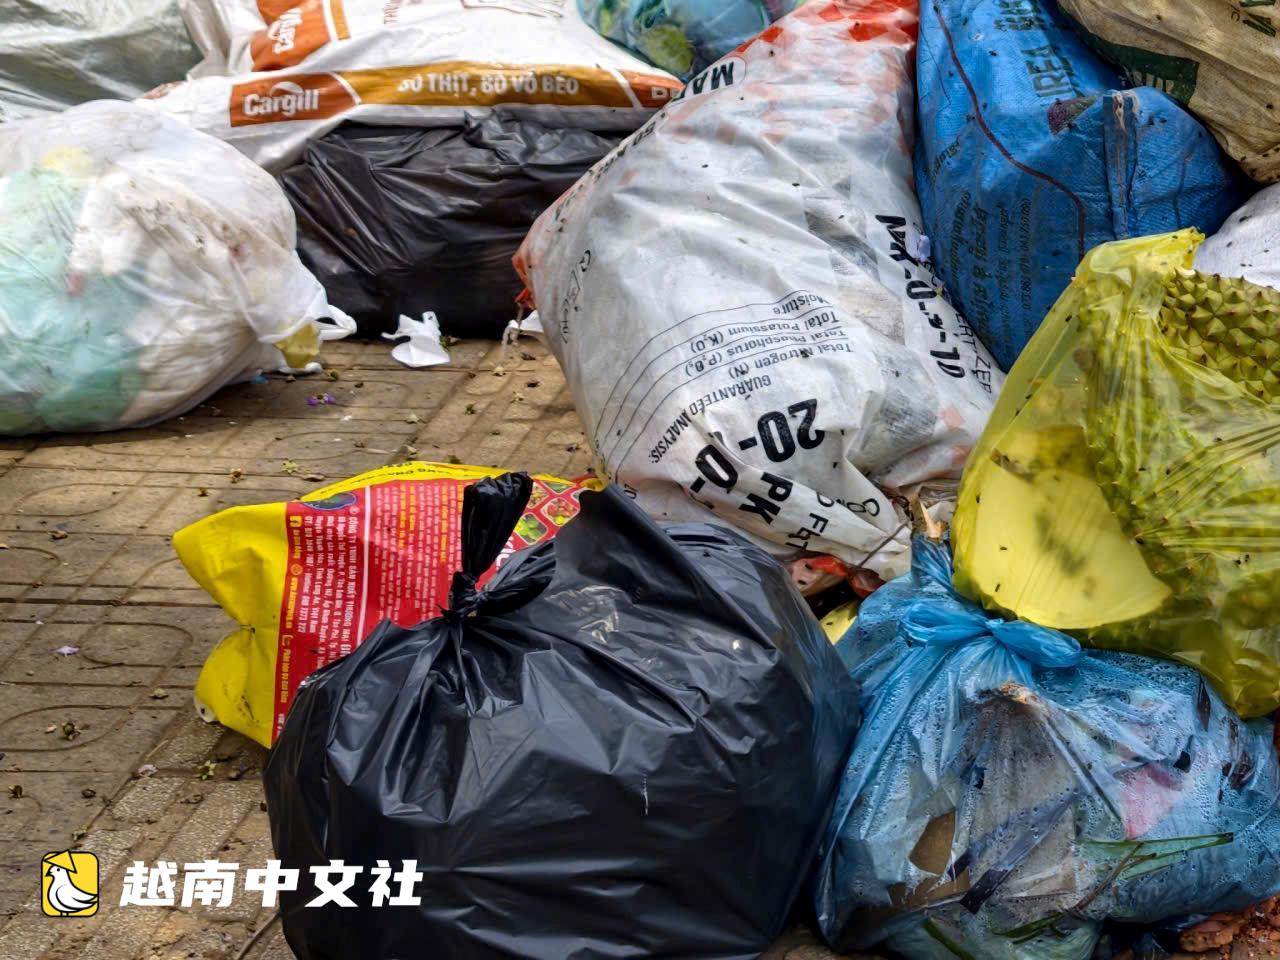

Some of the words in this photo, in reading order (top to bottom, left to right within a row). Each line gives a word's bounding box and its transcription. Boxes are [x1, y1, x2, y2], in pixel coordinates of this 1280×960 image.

[244, 87, 319, 119] Cargill
[772, 294, 829, 316] Moisture
[727, 322, 799, 336] Potassium
[804, 310, 839, 329] Total
[726, 335, 805, 357] Phosphorus
[808, 331, 845, 341] Total
[754, 348, 814, 370] Nitrogen
[817, 343, 852, 353] Total
[728, 361, 749, 379] (N)
[689, 375, 772, 414] GUARANTEED
[648, 409, 692, 464] ANALYSIS:
